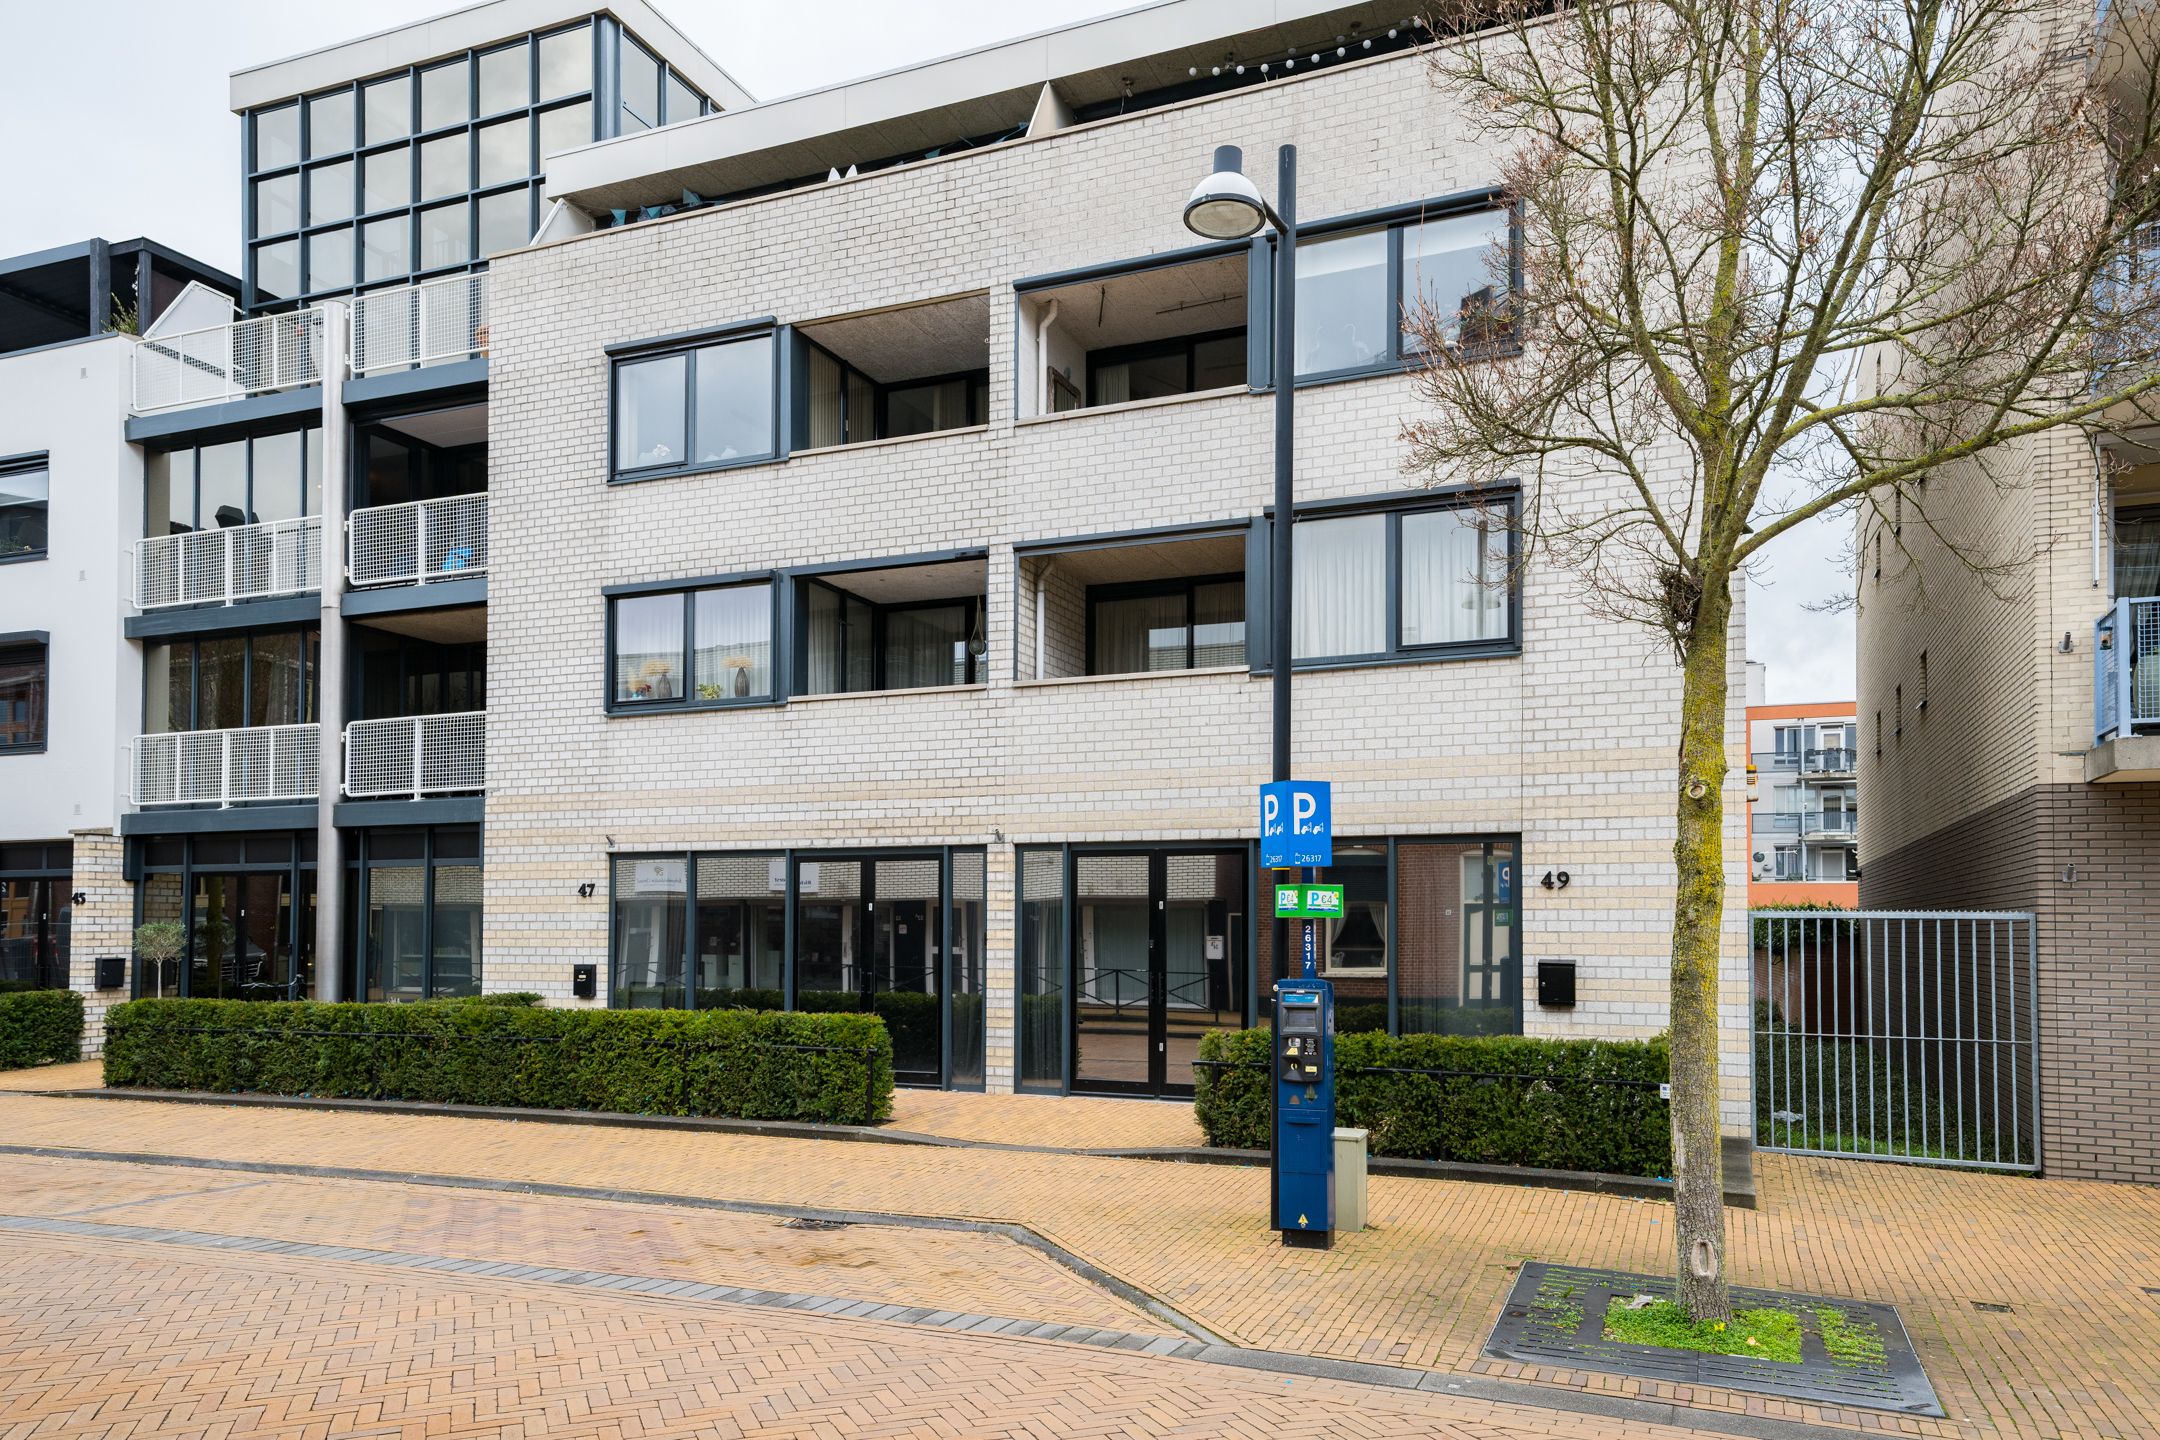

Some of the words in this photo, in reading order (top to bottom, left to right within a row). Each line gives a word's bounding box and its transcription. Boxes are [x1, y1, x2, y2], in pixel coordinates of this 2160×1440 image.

[1264, 794, 1279, 837] P
[1293, 792, 1316, 835] P
[1269, 854, 1283, 863] 26317
[1301, 854, 1322, 862] 26317
[1541, 870, 1570, 889] 49
[578, 883, 595, 898] 47
[72, 892, 86, 906] 45
[1280, 892, 1286, 905] P
[1311, 892, 1320, 906] P
[1321, 895, 1332, 904] €4
[1304, 925, 1312, 970] 26317
